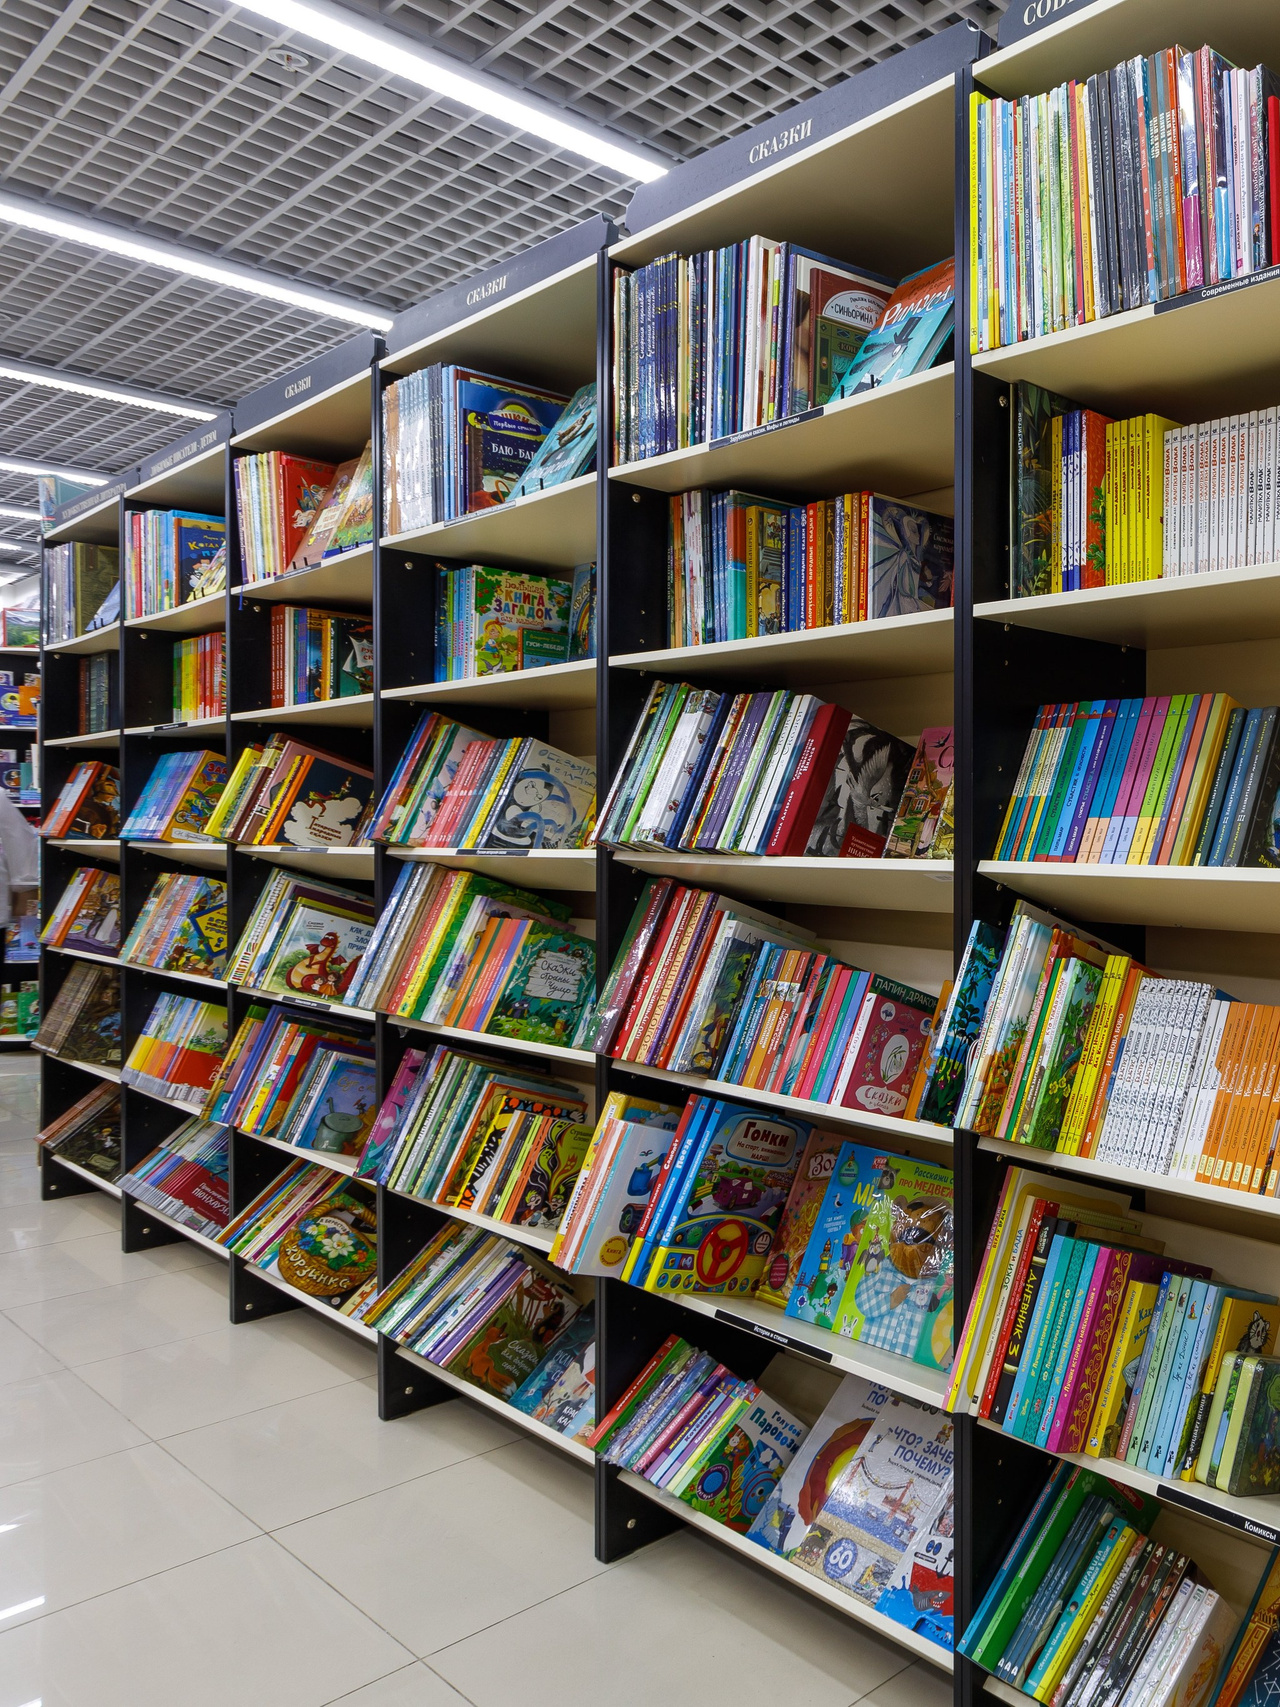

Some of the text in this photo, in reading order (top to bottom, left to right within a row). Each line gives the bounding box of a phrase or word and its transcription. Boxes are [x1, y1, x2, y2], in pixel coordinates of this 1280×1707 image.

[749, 119, 813, 164] СКАЗКИ
[466, 275, 507, 306] СКАЗКИ
[1202, 277, 1249, 299] Современные
[1250, 268, 1279, 285] издания
[835, 303, 873, 325] СИНЬОРИНА
[285, 376, 311, 398] СКАЗКИ
[493, 599, 553, 621] ЗАГАДОК
[505, 589, 545, 608] КНИГА
[742, 1122, 790, 1148] Гонки
[1013, 1268, 1038, 1334] ДНЕВНИК
[753, 1325, 771, 1338] Истории
[1244, 1520, 1277, 1541] Комиксы
[828, 1546, 854, 1571] 60
